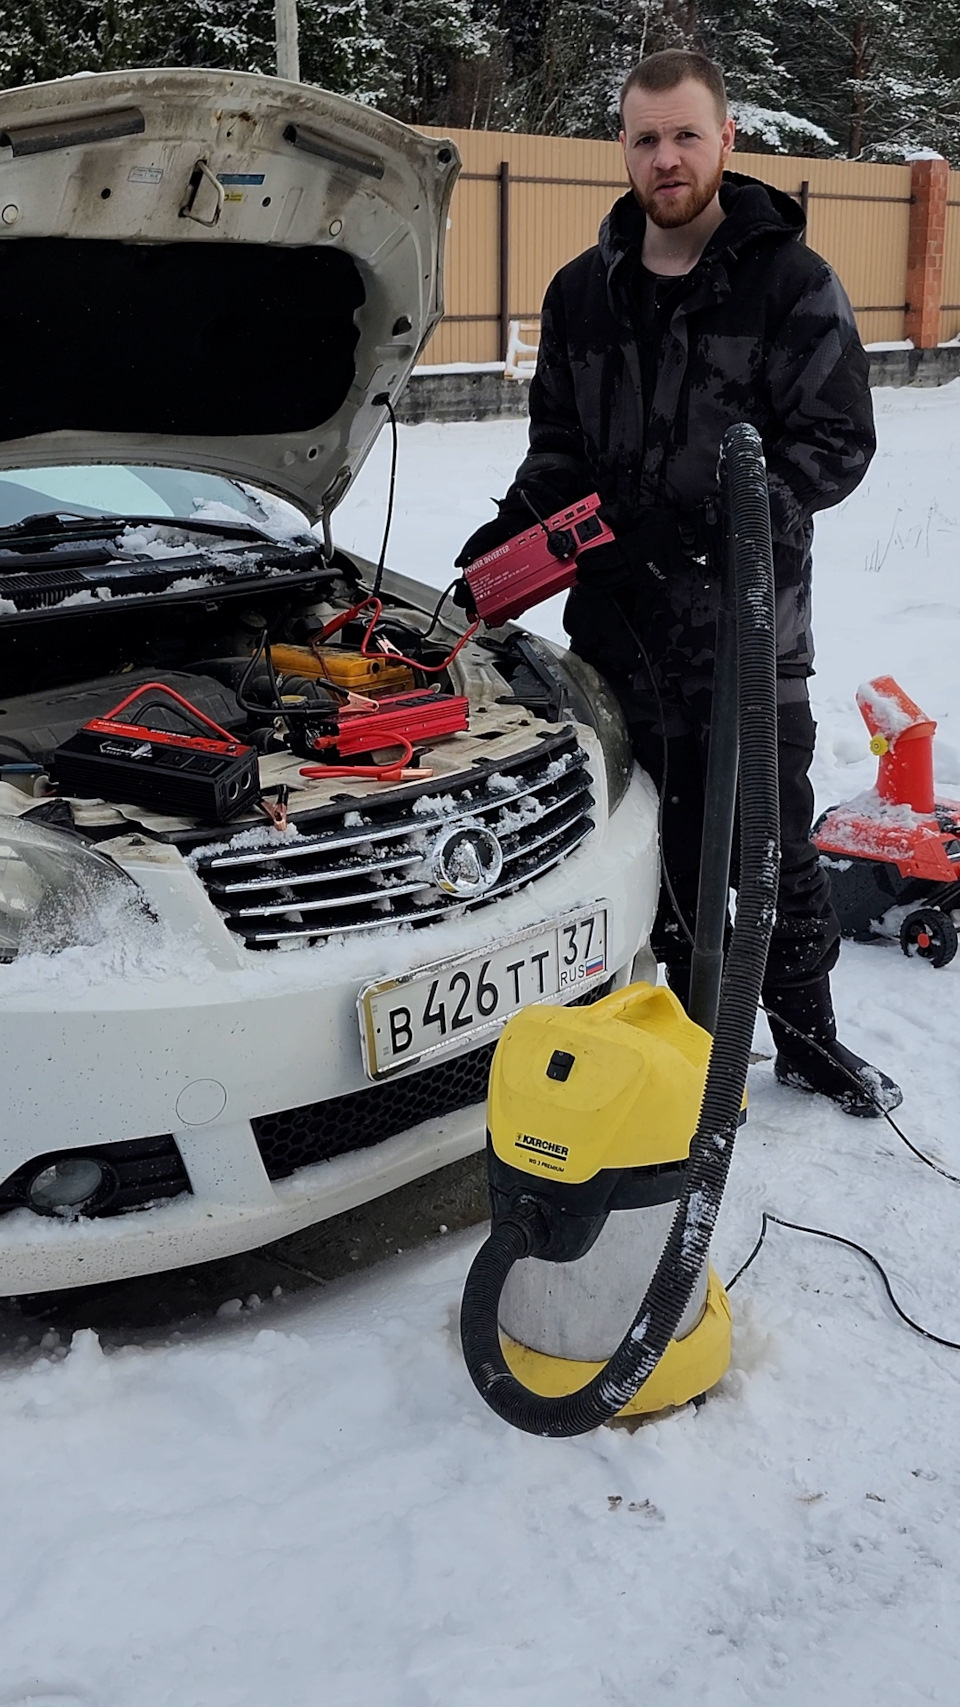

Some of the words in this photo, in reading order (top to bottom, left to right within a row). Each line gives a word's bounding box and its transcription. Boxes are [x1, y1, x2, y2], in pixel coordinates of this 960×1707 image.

[464, 559, 483, 575] POWER
[483, 545, 510, 564] INVERTER
[389, 1006, 413, 1055] B
[422, 960, 499, 1036] 426
[506, 951, 549, 1004] TT
[563, 917, 595, 966] 37
[560, 963, 585, 986] RUS
[541, 1162, 564, 1172] PREMIUM
